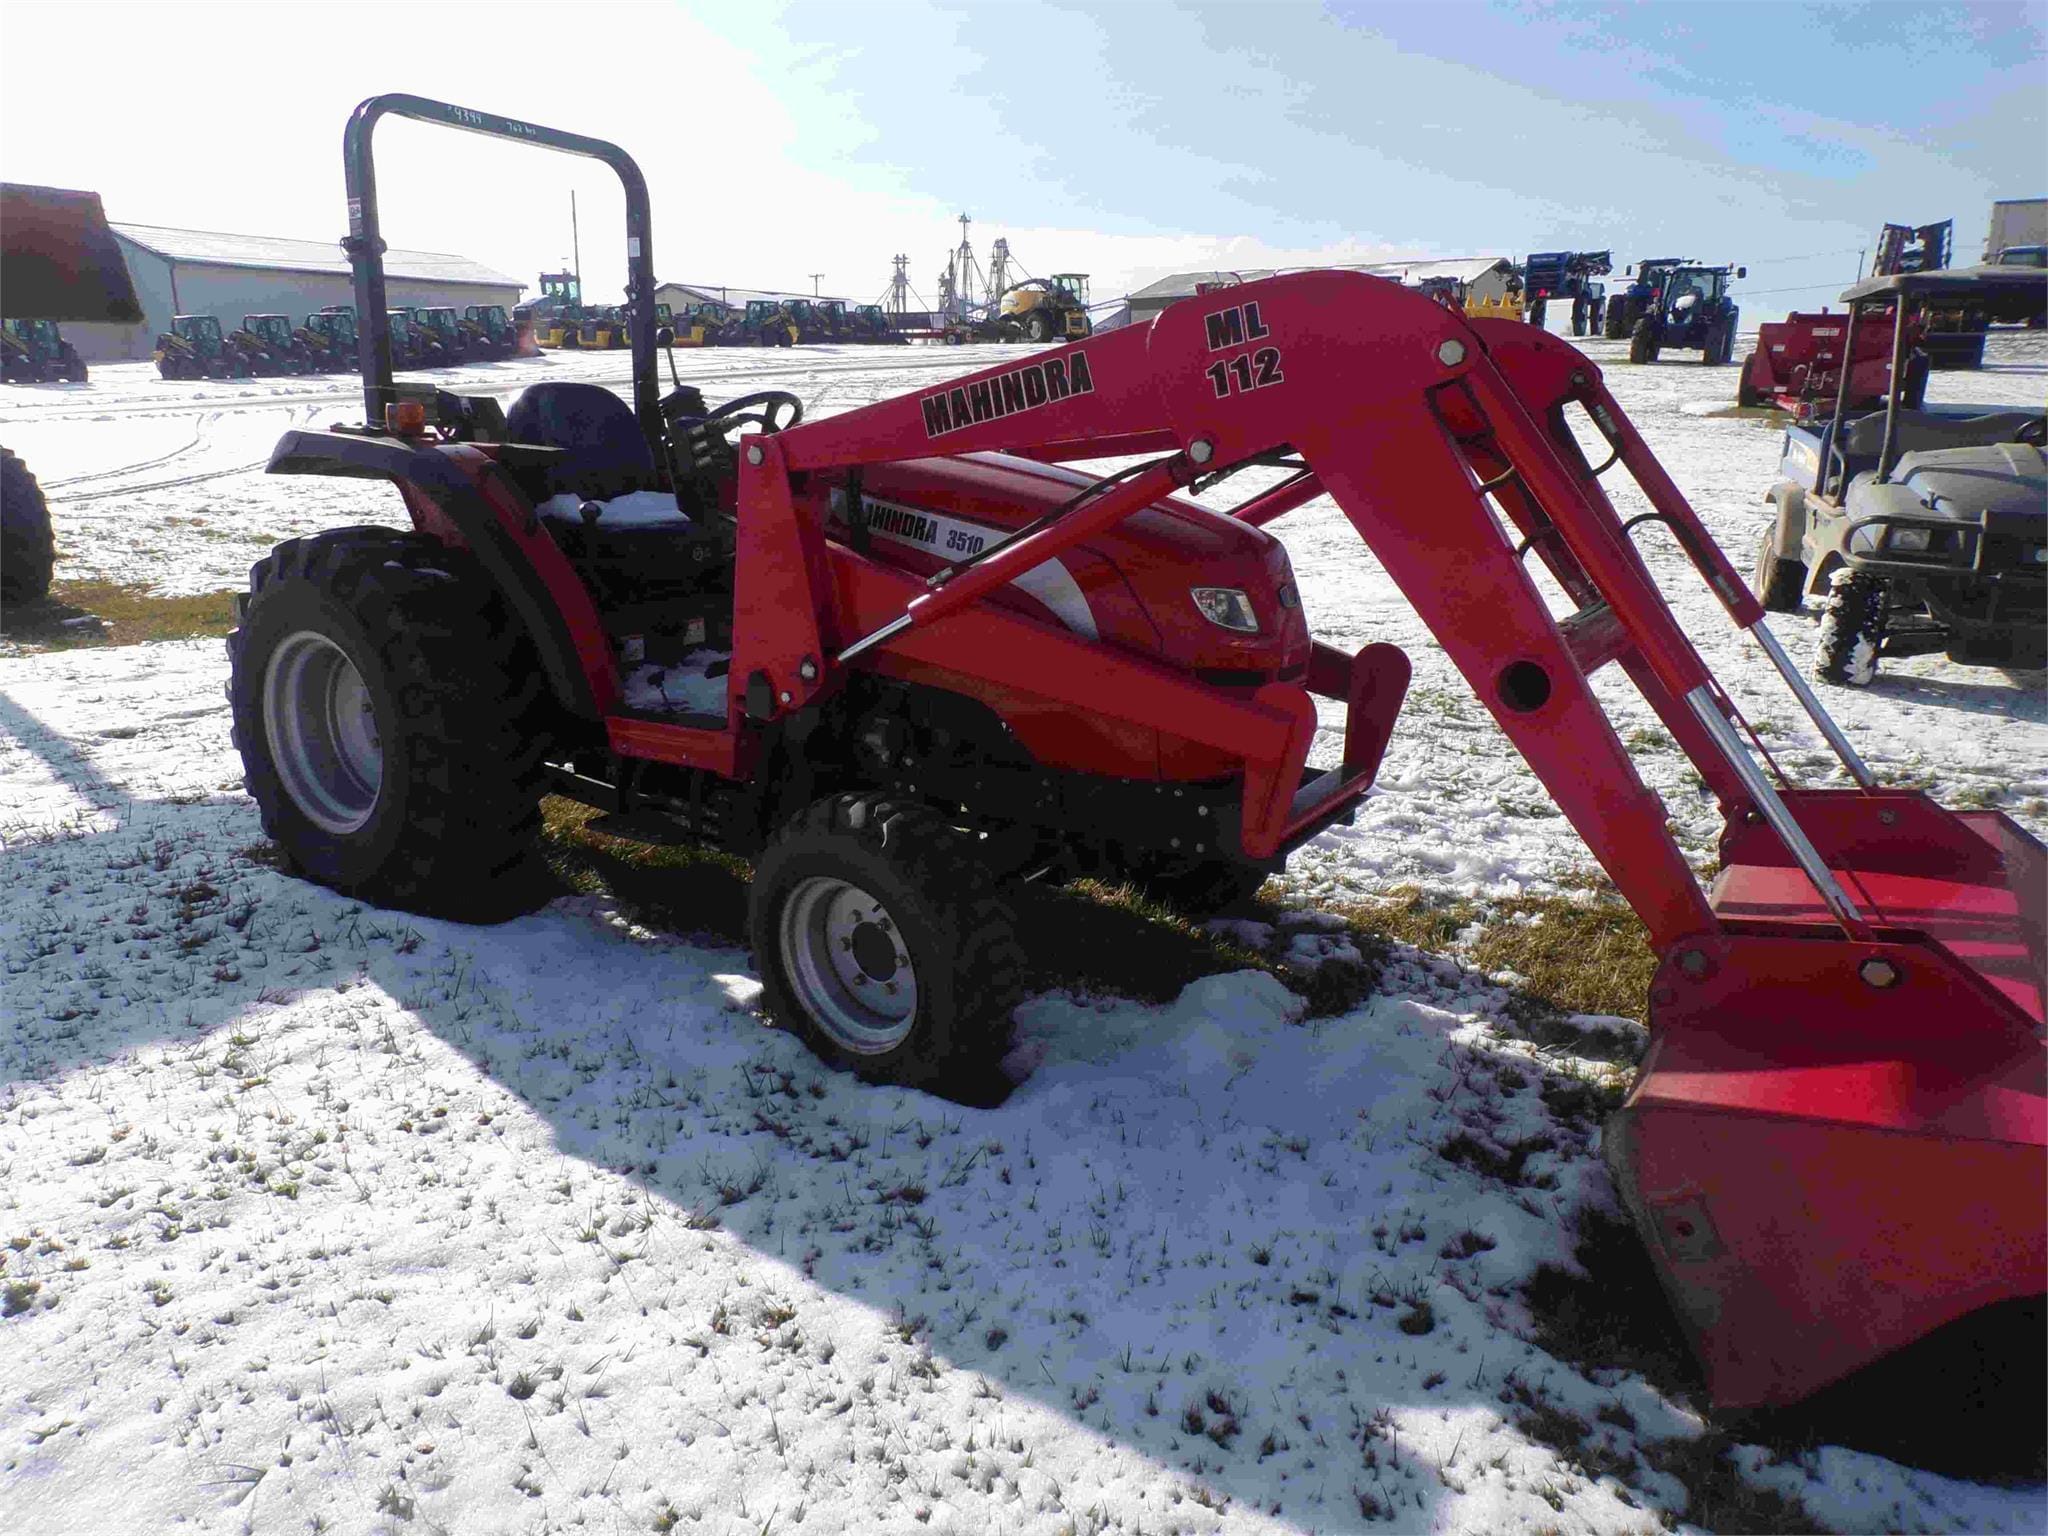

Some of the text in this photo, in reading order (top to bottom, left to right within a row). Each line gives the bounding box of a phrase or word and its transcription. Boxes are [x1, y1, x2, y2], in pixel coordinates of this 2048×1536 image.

[1204, 301, 1270, 352] ML
[920, 350, 1095, 439] MAHINDRA
[1206, 347, 1285, 399] 112
[861, 501, 985, 554] AHINDRA 3510
